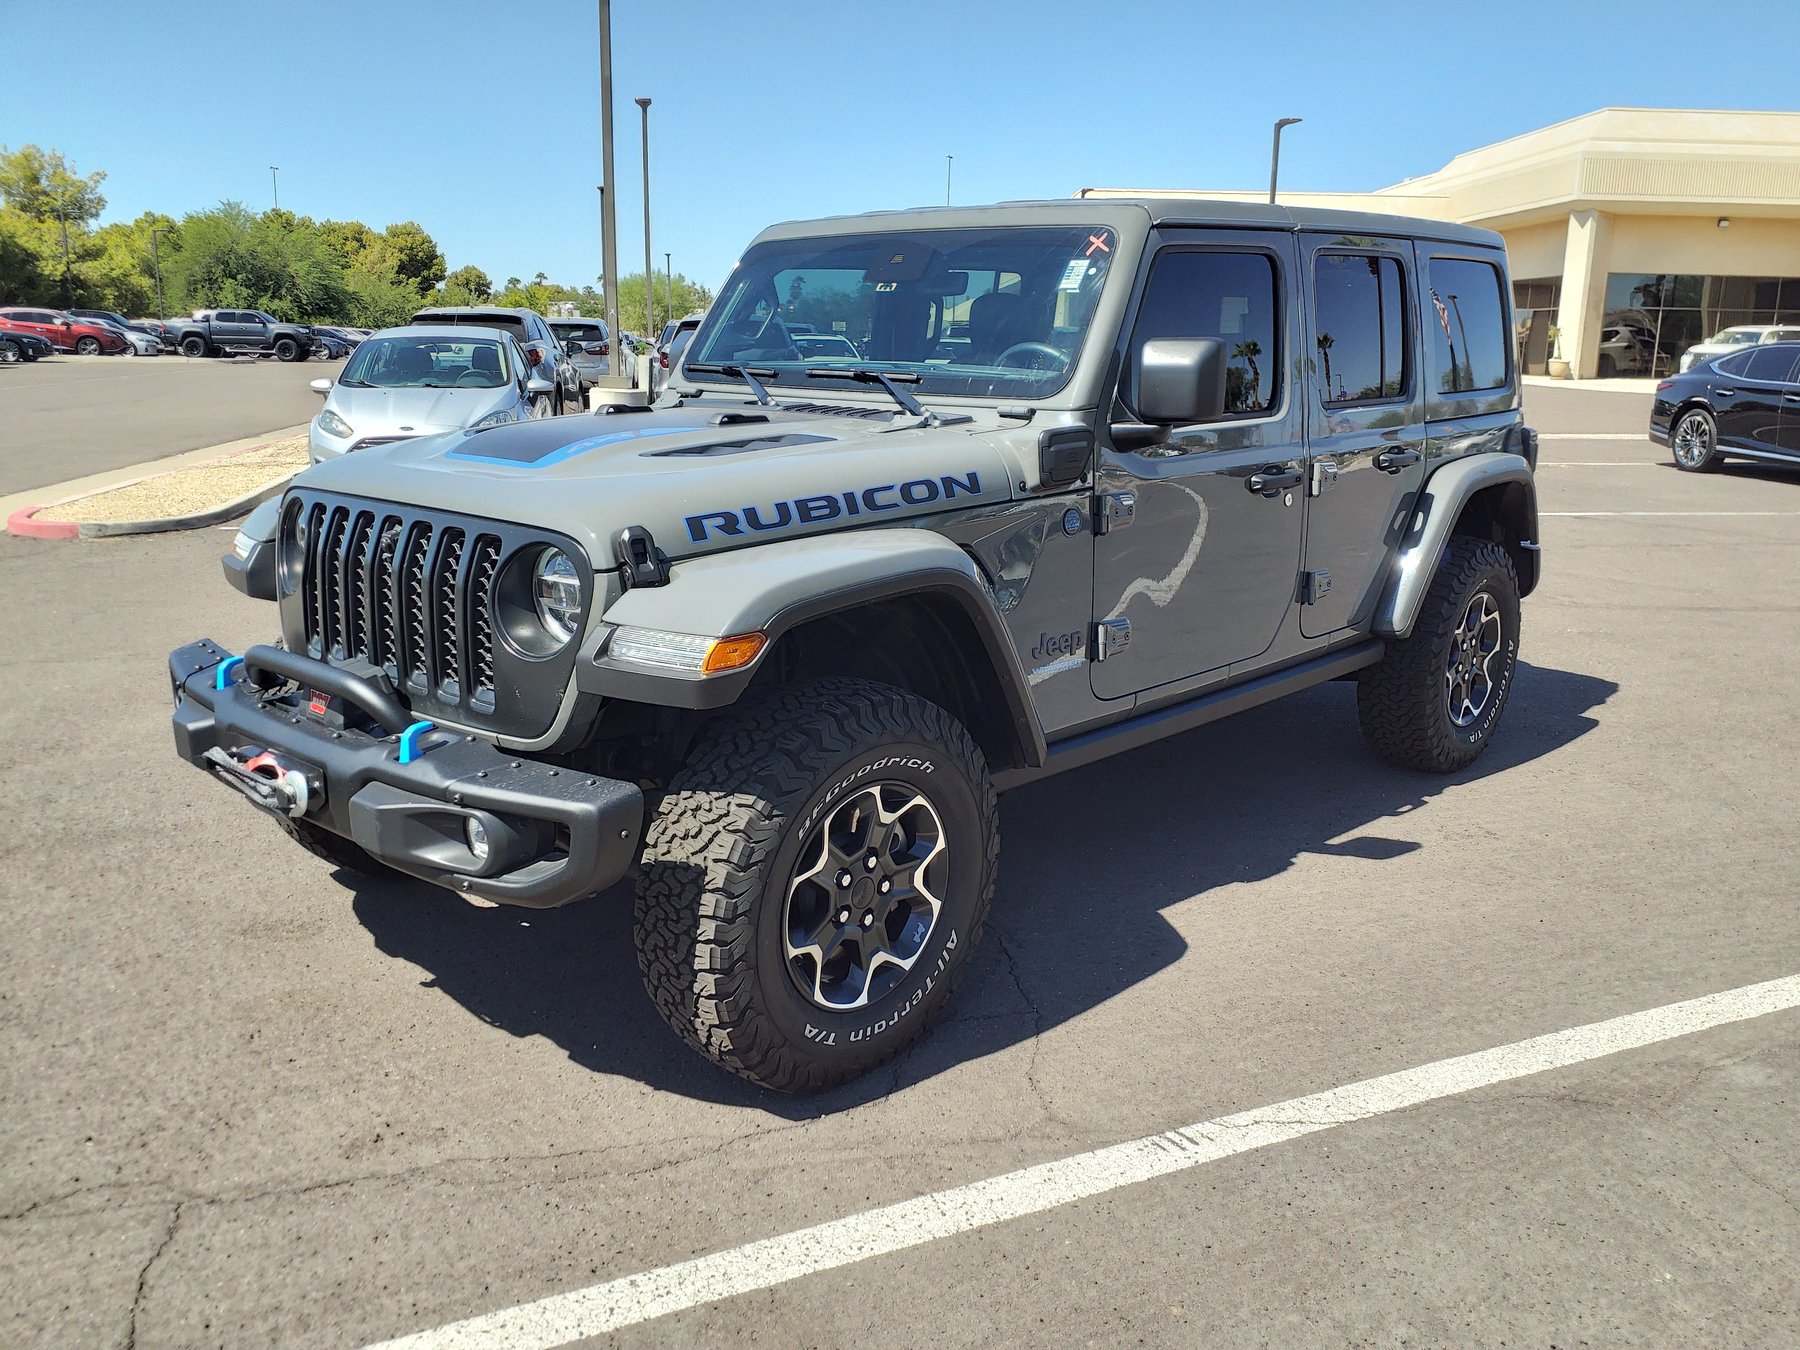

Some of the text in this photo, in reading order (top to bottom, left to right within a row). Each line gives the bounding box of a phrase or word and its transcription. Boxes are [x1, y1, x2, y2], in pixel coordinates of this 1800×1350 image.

[683, 471, 983, 544] RUBICON
[1031, 630, 1082, 660] Jeep
[1469, 730, 1484, 744] T/A
[798, 755, 936, 842] BFGoodrich
[803, 928, 959, 1046] All-Terrain T/A
